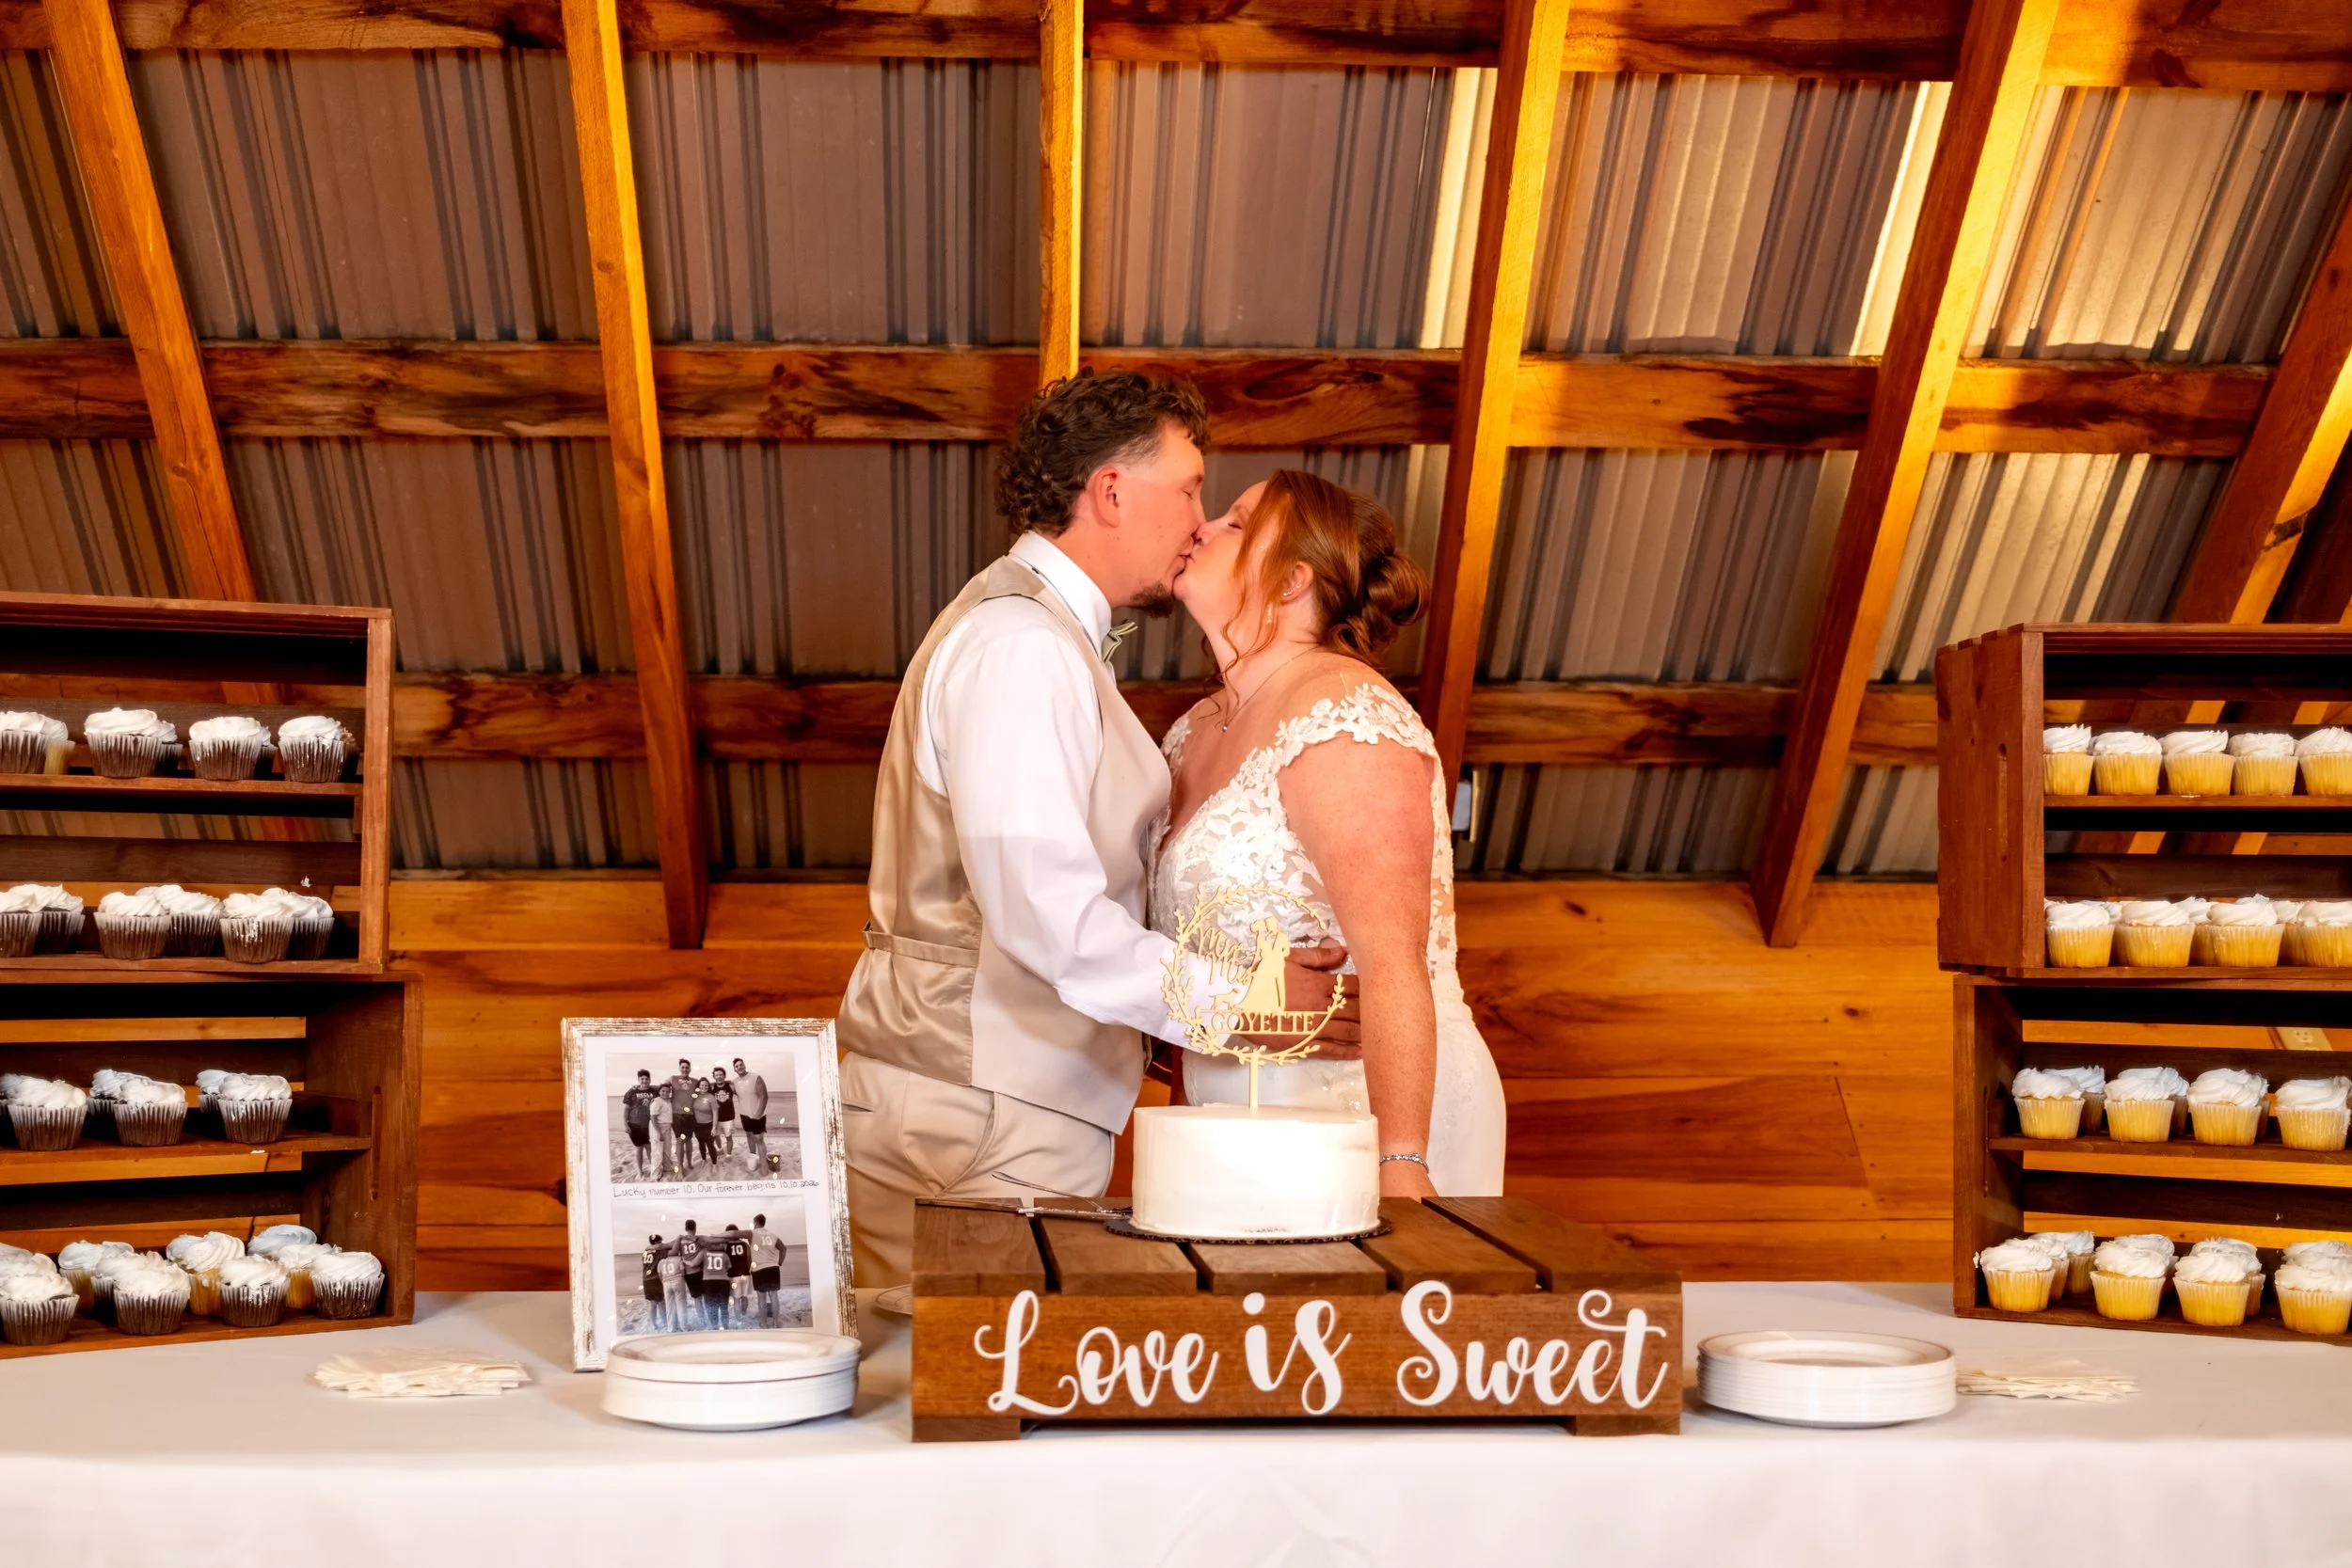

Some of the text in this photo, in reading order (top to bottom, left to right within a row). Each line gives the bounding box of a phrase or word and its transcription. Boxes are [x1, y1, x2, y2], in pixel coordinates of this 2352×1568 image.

[1211, 1011, 1315, 1033] GOYETTE
[649, 1186, 679, 1196] number
[697, 1183, 712, 1193] Our
[715, 1182, 743, 1193] forever
[746, 1182, 776, 1191] begins
[761, 1236, 773, 1245] 10
[683, 1243, 696, 1255] 10
[731, 1244, 744, 1256] 10
[662, 1262, 675, 1274] 10
[707, 1256, 723, 1270] 10
[975, 1281, 1667, 1415] Love is Sweet
